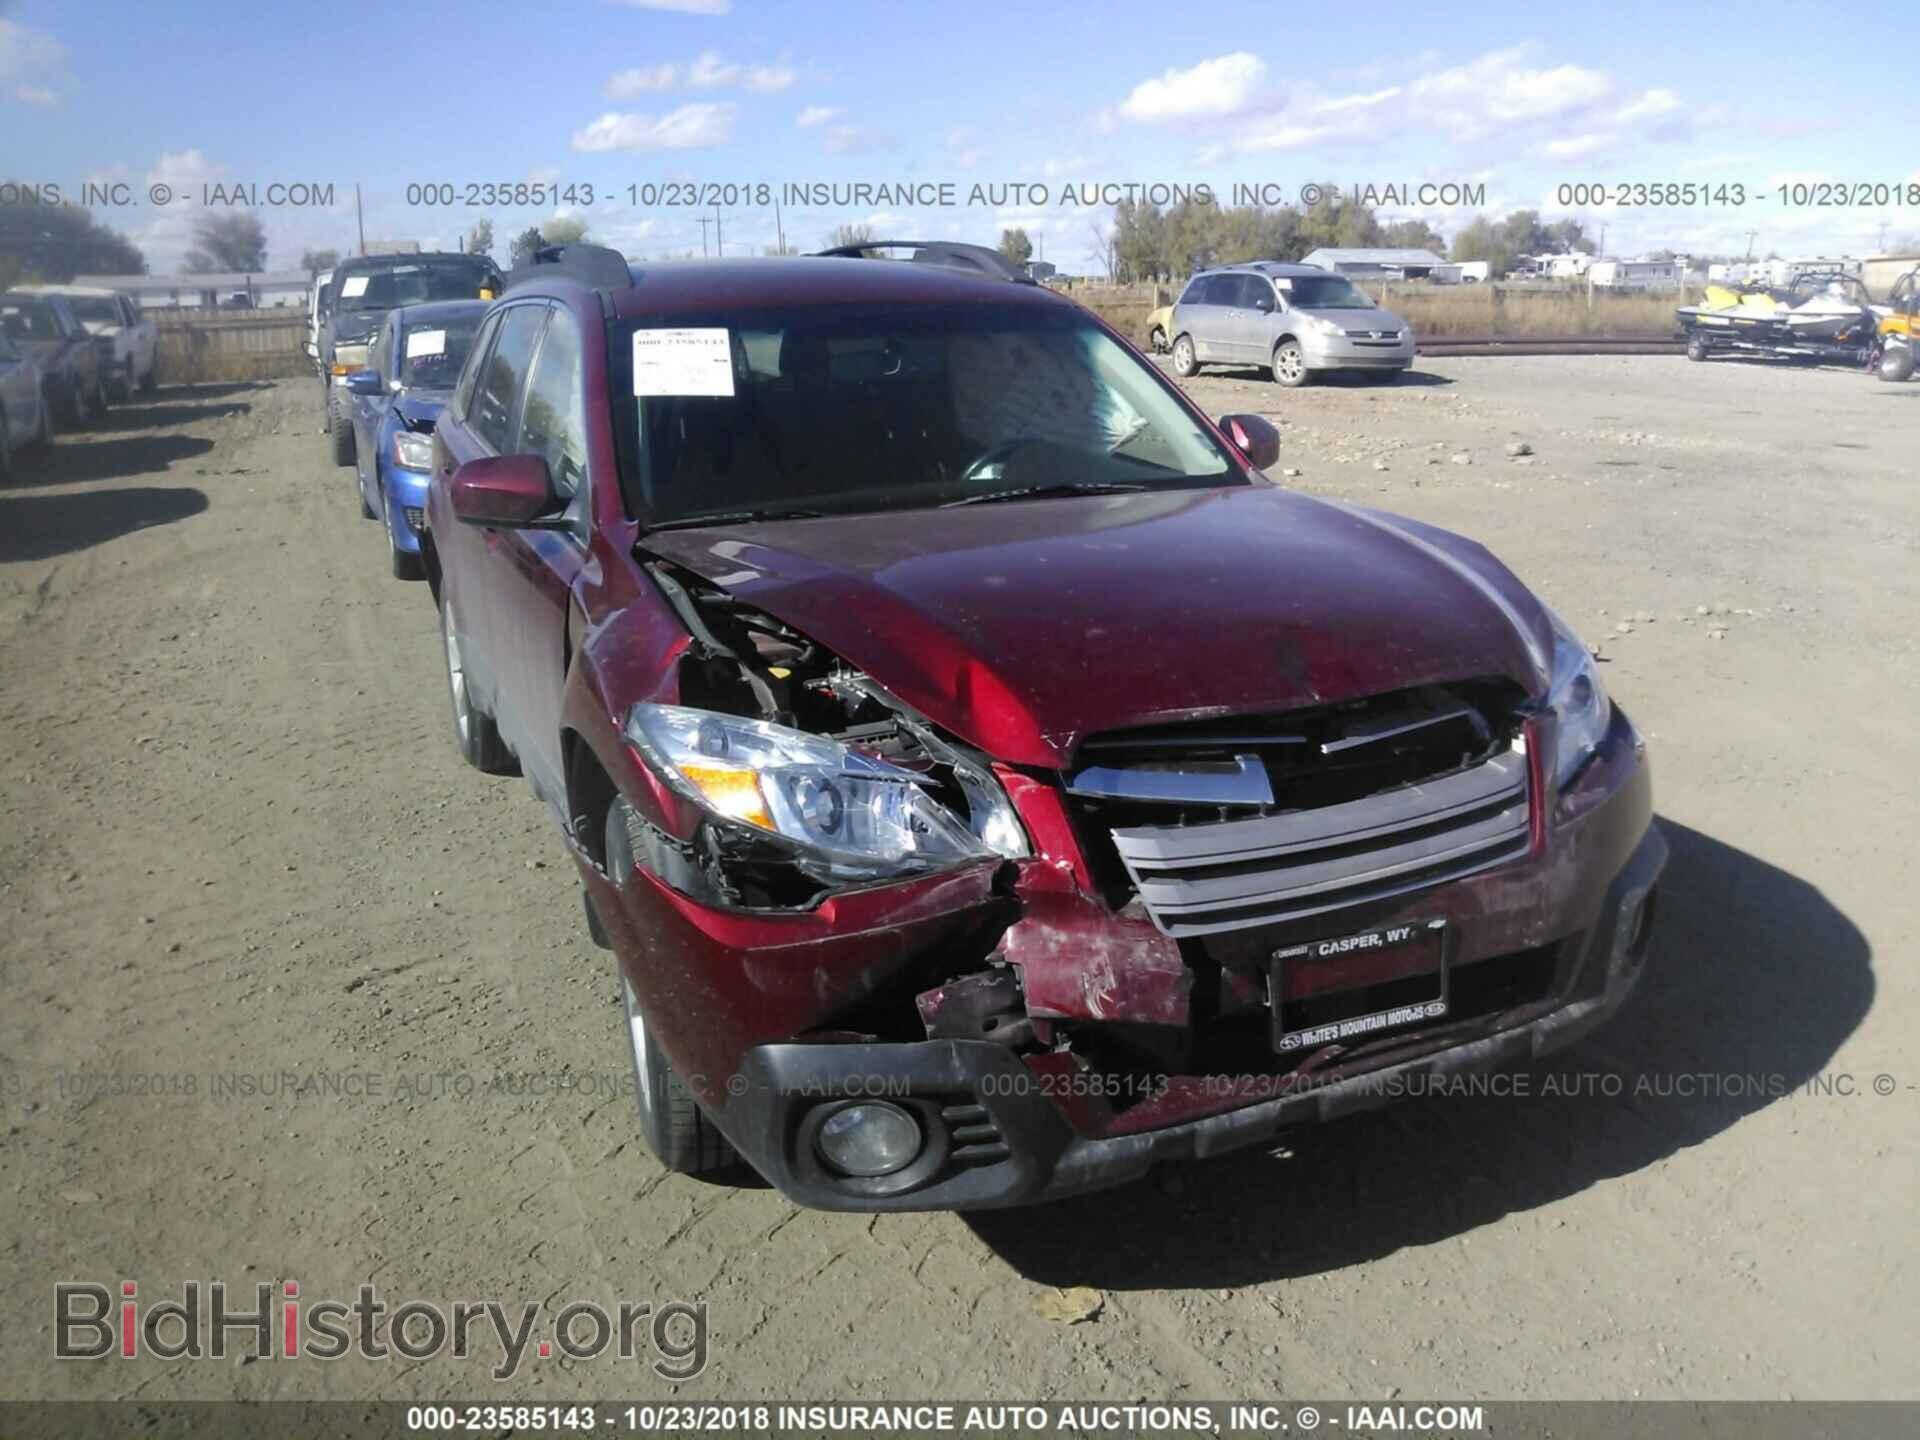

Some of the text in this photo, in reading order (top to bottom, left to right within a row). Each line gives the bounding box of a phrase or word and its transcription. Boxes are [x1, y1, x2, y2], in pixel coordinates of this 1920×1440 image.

[1319, 934, 1382, 955] CASPER,
[1386, 927, 1410, 942] WY
[1340, 1014, 1387, 1036] MOUNTAIN
